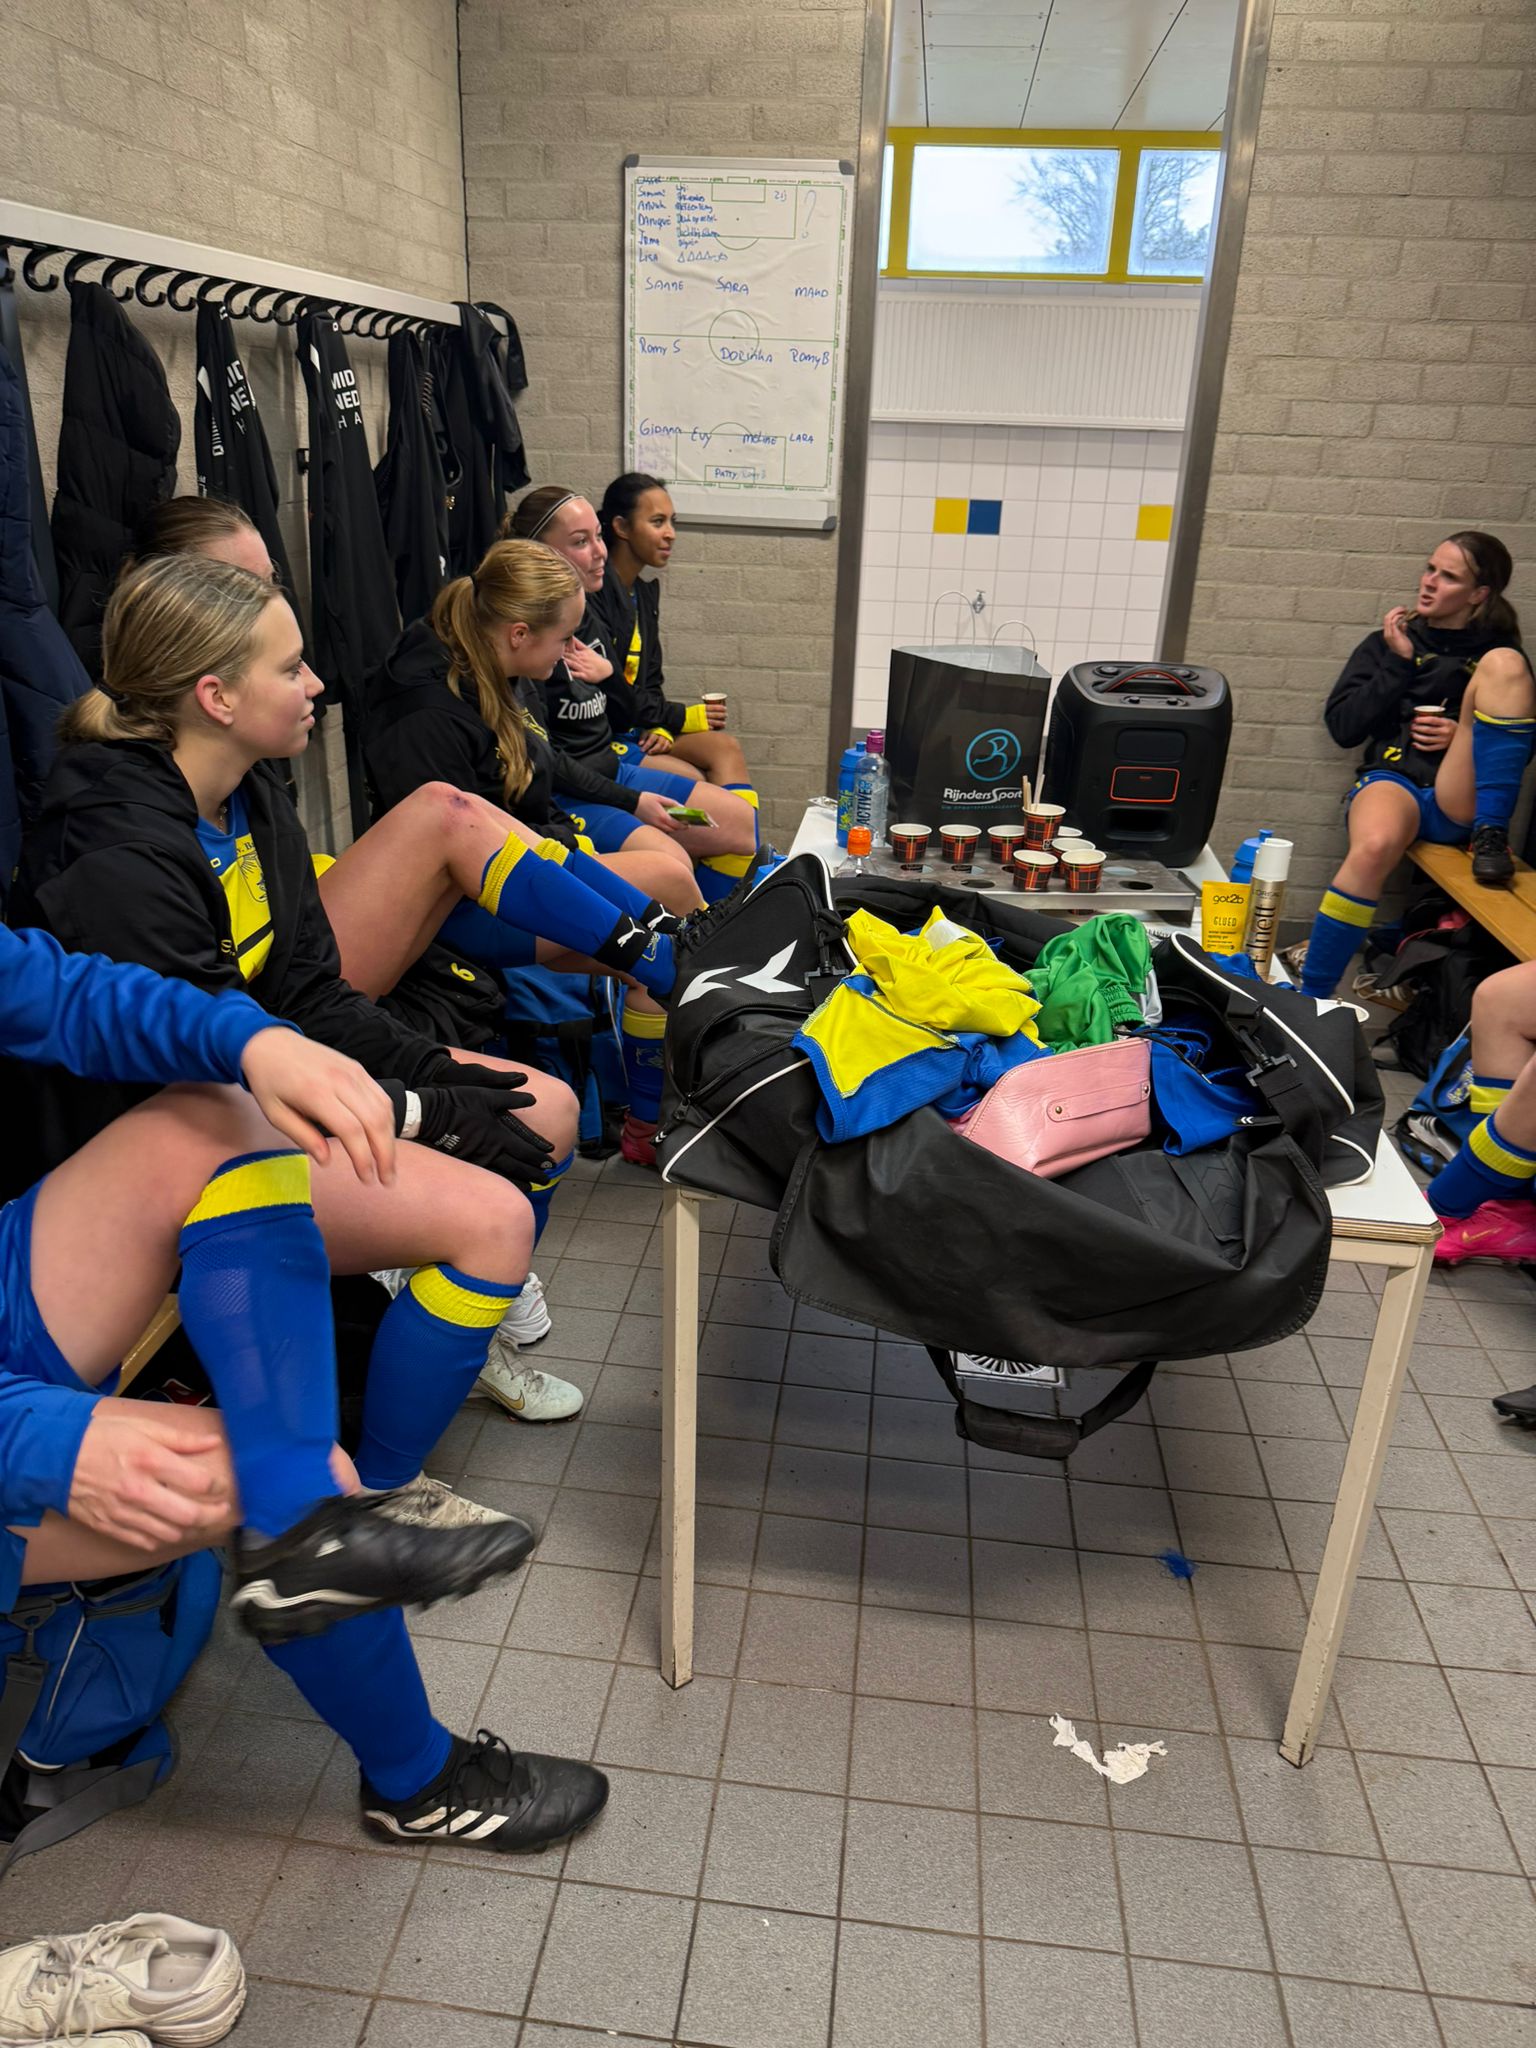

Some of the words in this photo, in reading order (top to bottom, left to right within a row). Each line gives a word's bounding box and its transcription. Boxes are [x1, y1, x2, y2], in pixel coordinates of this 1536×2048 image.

[715, 276, 749, 295] SARA
[639, 337, 667, 355] Romy
[672, 339, 681, 354] S
[821, 351, 830, 366] B
[229, 386, 250, 415] NE
[691, 426, 713, 448] Evy
[789, 433, 814, 444] LARA
[610, 741, 628, 755] 8
[857, 788, 872, 826] ACTIVE
[1213, 894, 1244, 905] got2b
[1213, 916, 1237, 927] GLUED
